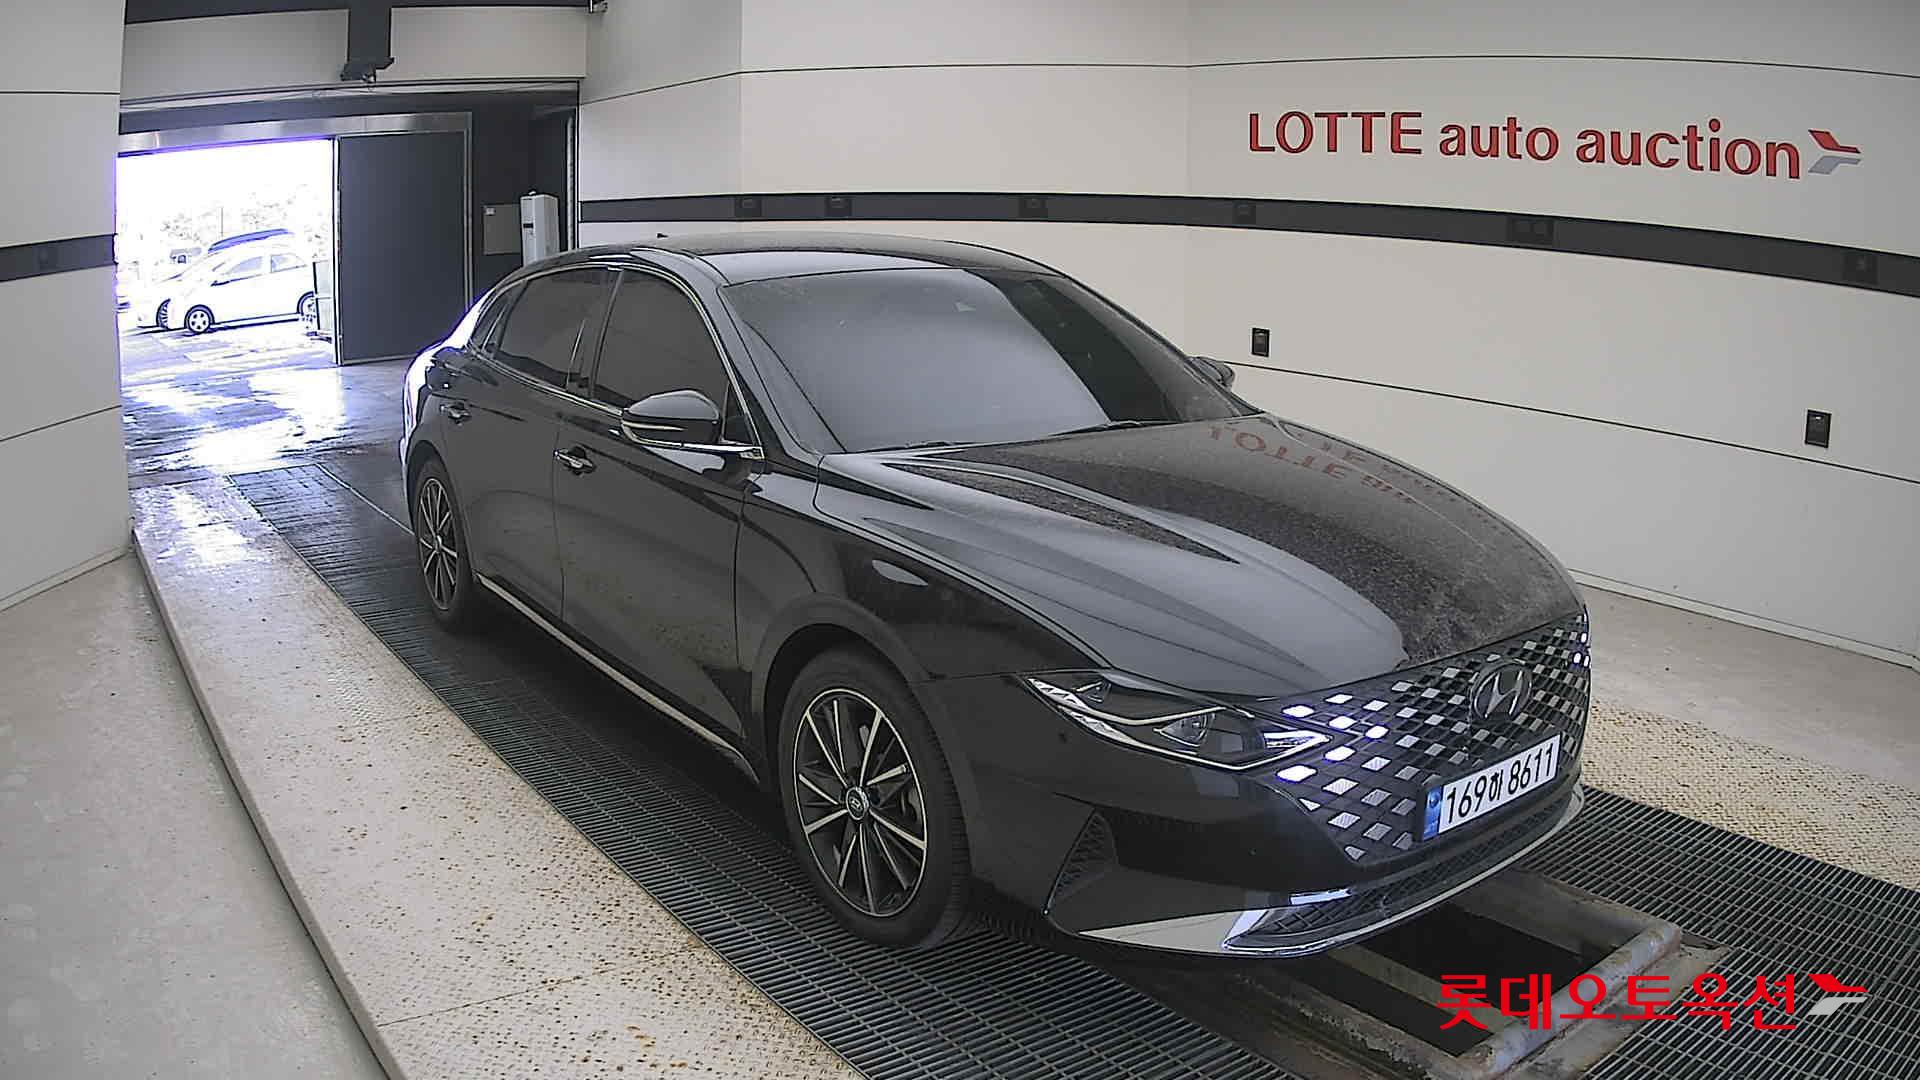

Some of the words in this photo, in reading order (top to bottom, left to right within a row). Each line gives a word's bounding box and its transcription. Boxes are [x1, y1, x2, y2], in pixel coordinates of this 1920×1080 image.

[1248, 110, 1423, 155] LOTTE
[1439, 117, 1560, 161] auto
[1575, 119, 1801, 180] auction
[1446, 769, 1503, 824] 169하
[1507, 742, 1554, 795] 8611
